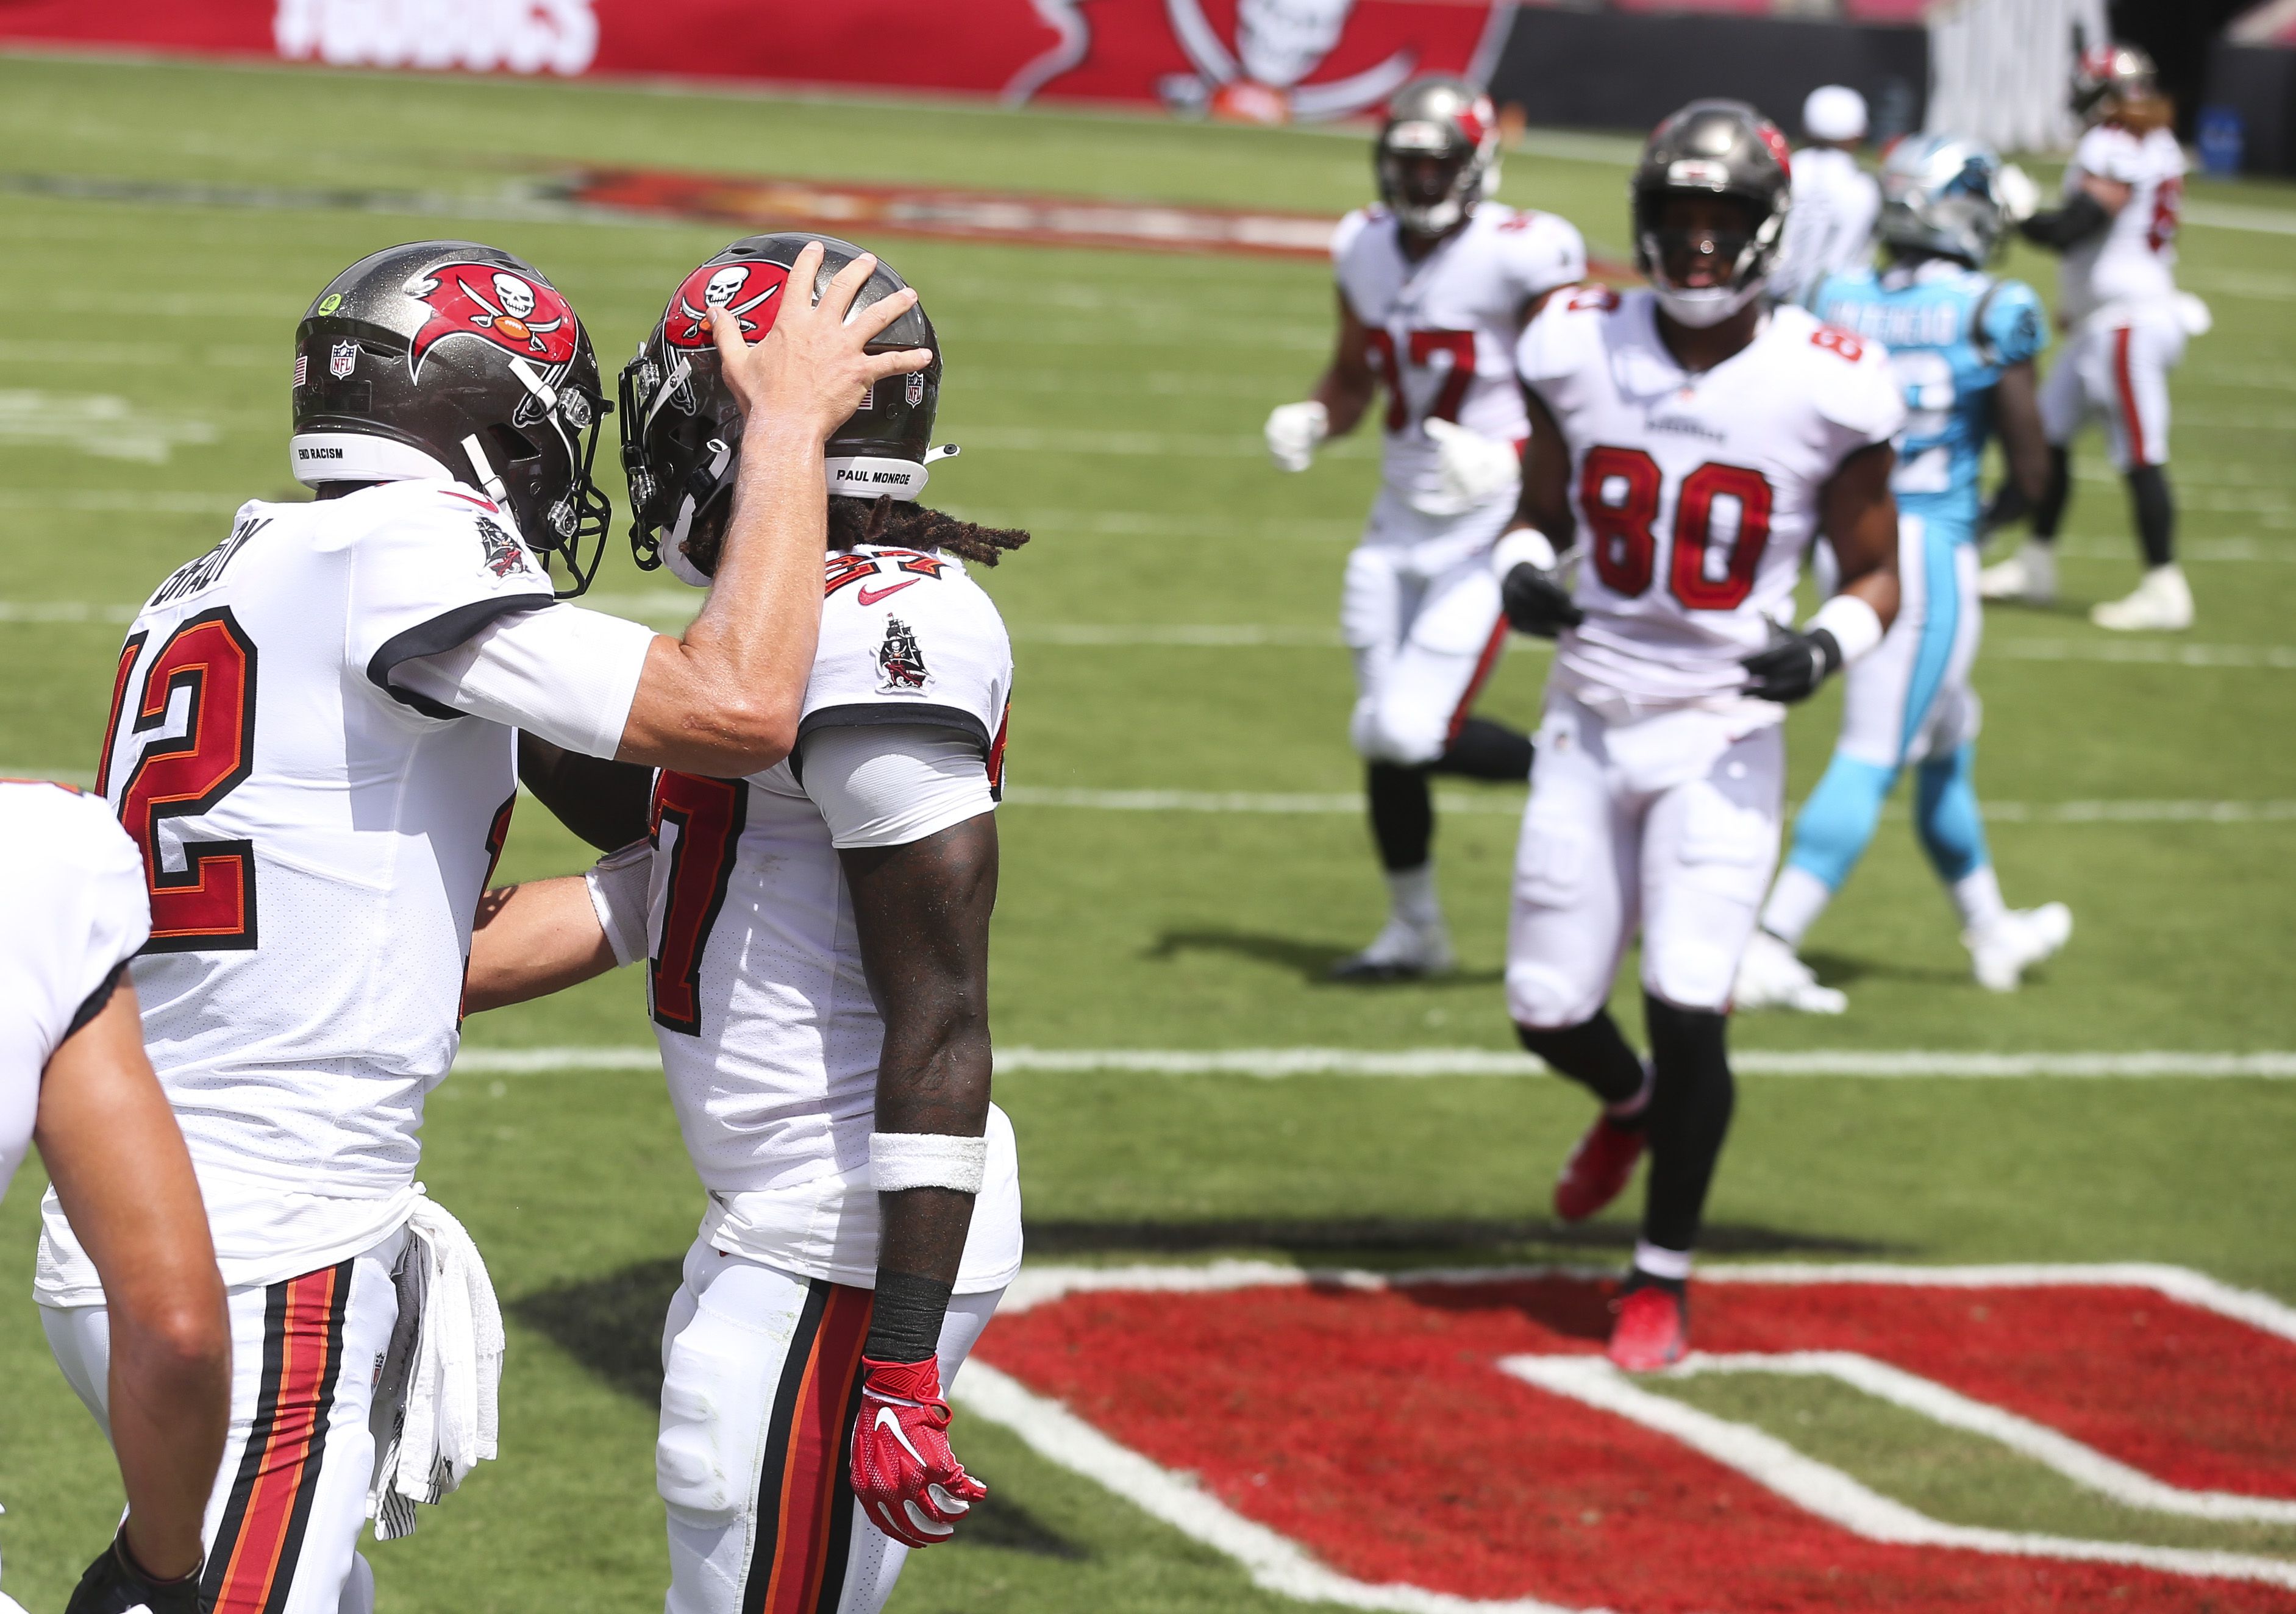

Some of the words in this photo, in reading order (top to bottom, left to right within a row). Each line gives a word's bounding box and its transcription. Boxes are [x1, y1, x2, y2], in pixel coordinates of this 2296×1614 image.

[333, 357, 351, 372] NFL
[908, 386, 921, 402] NFL
[298, 449, 310, 460] END
[310, 448, 343, 459] RACISM
[836, 469, 869, 482] PAUL
[872, 472, 911, 485] MONROE
[1580, 444, 1773, 611] 80
